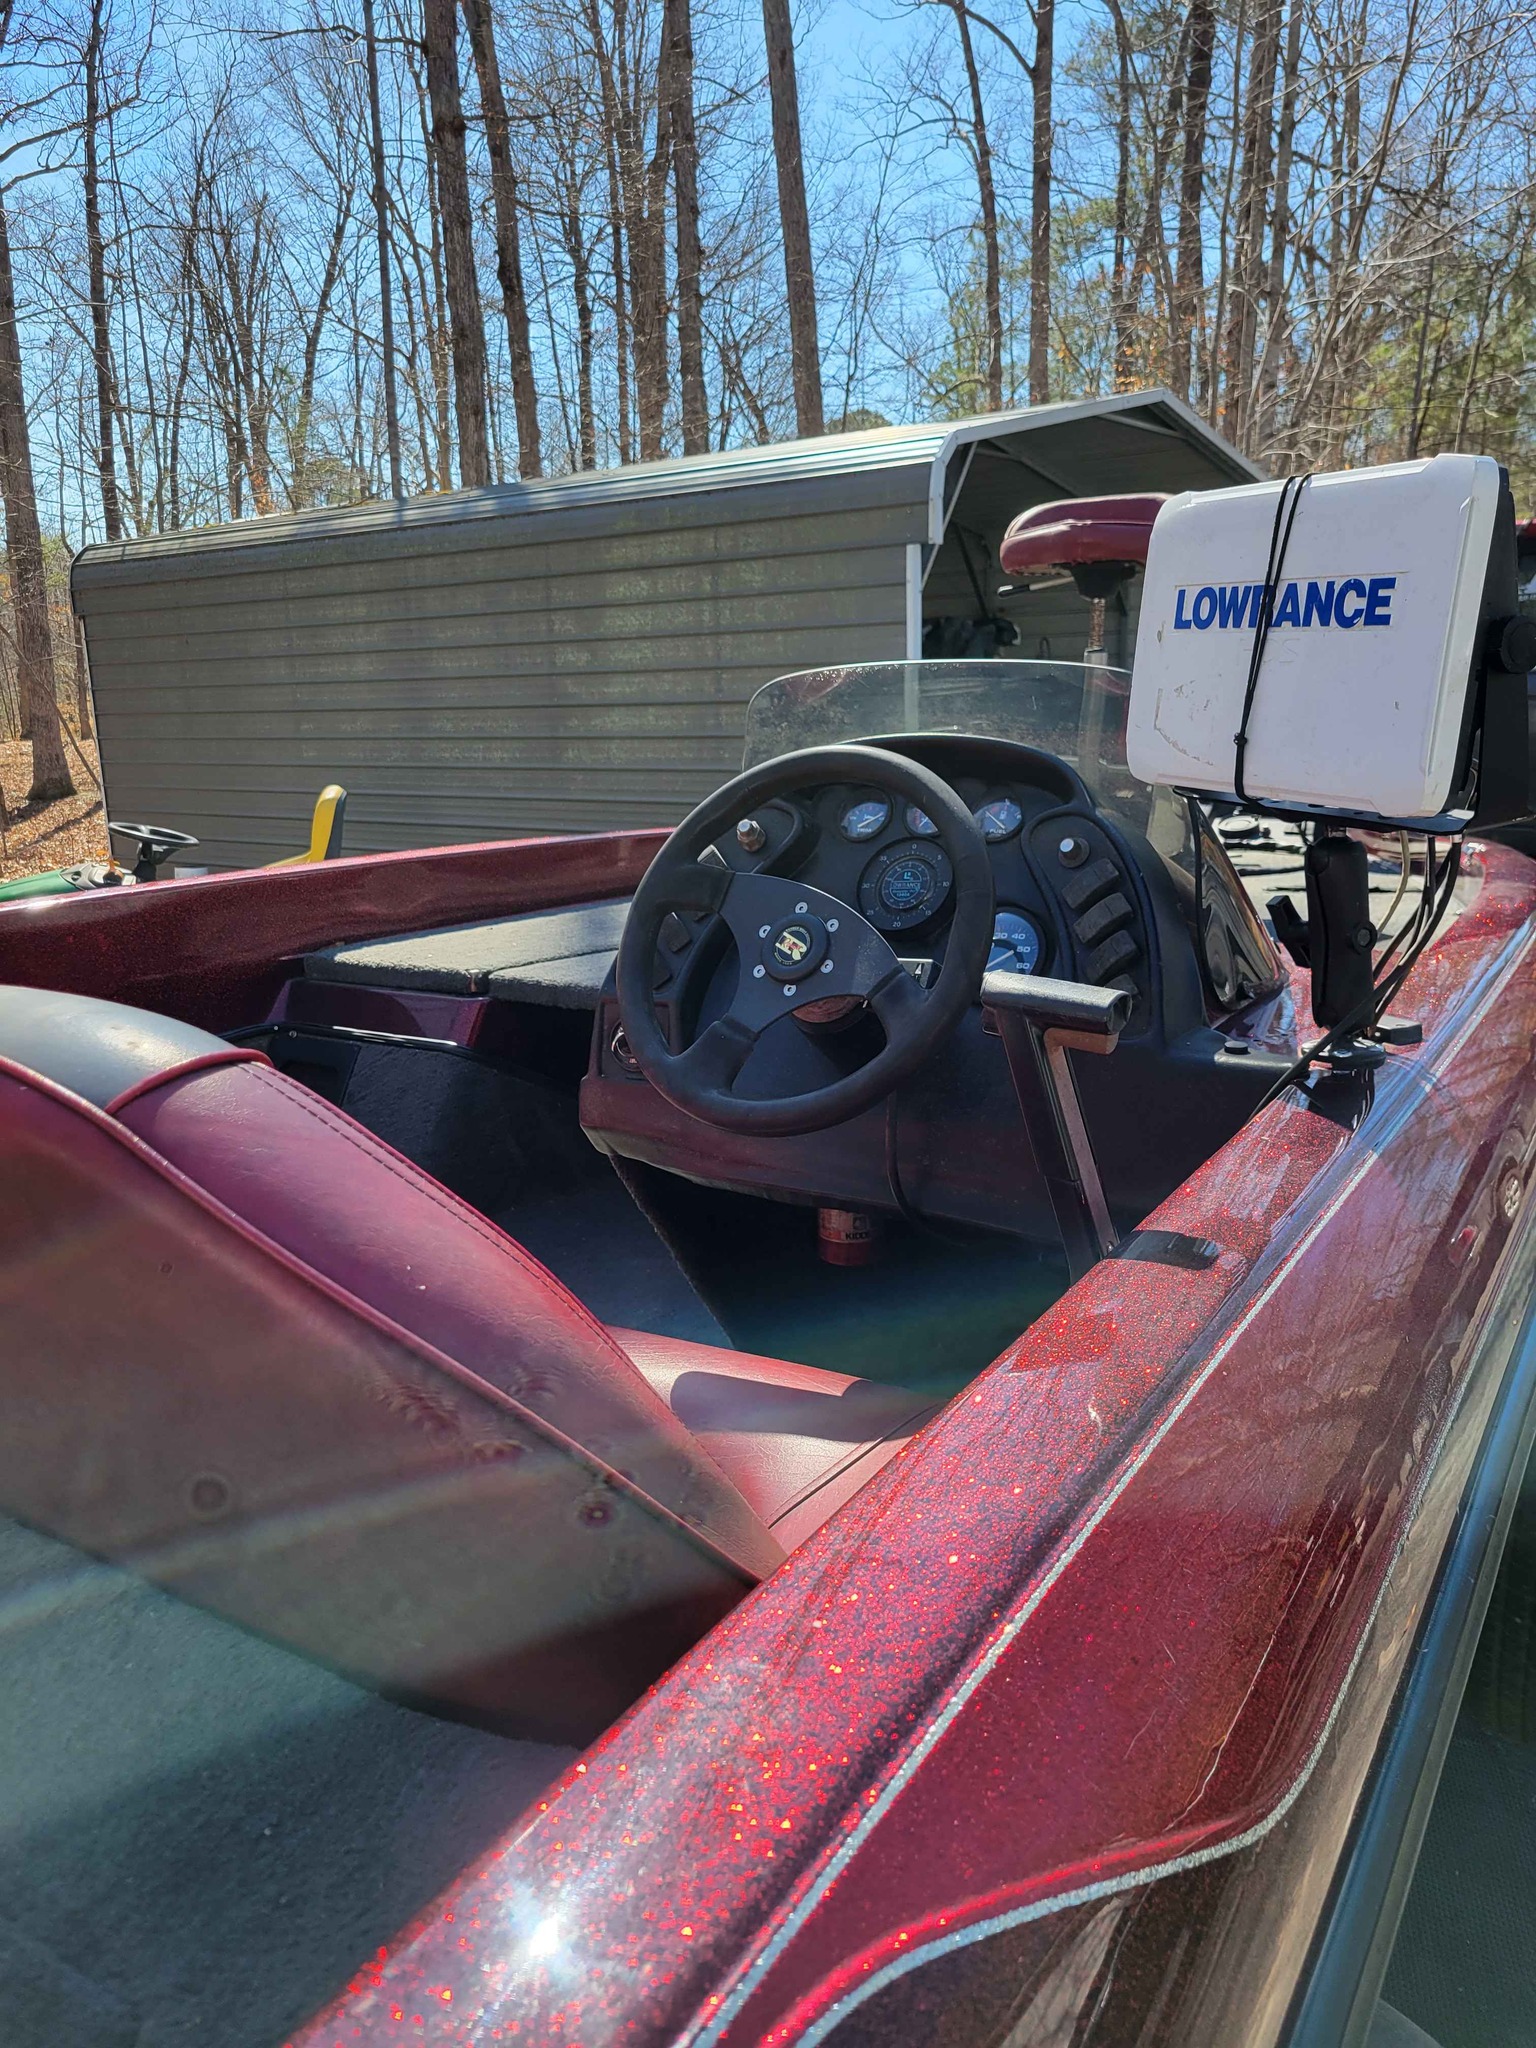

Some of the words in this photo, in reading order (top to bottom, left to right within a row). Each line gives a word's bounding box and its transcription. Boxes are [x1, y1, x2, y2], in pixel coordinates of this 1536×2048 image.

[1173, 577, 1397, 630] LOWRANCE
[1016, 945, 1031, 953] 50
[1016, 962, 1030, 970] 60
